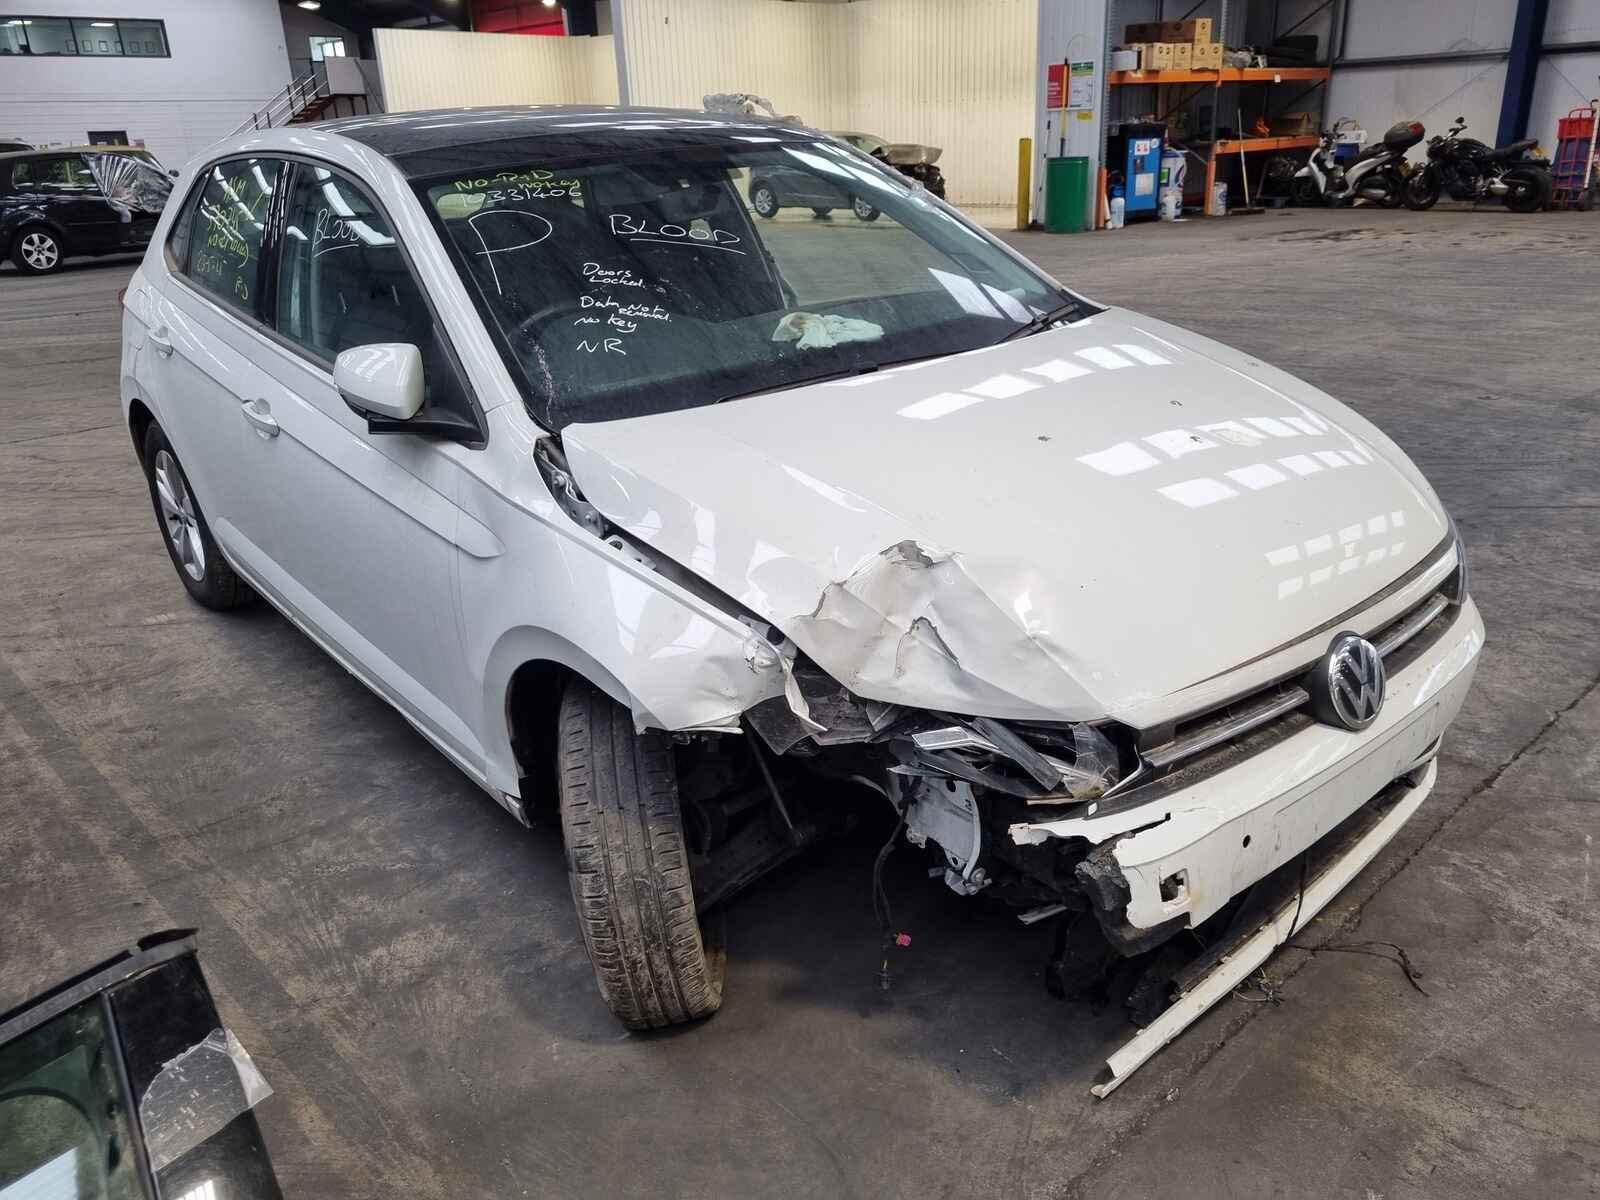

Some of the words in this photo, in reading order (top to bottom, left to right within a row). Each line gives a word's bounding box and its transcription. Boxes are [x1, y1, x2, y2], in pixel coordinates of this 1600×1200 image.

[608, 214, 741, 243] BLOOD
[582, 262, 632, 277] Doors
[576, 338, 627, 355] NR
